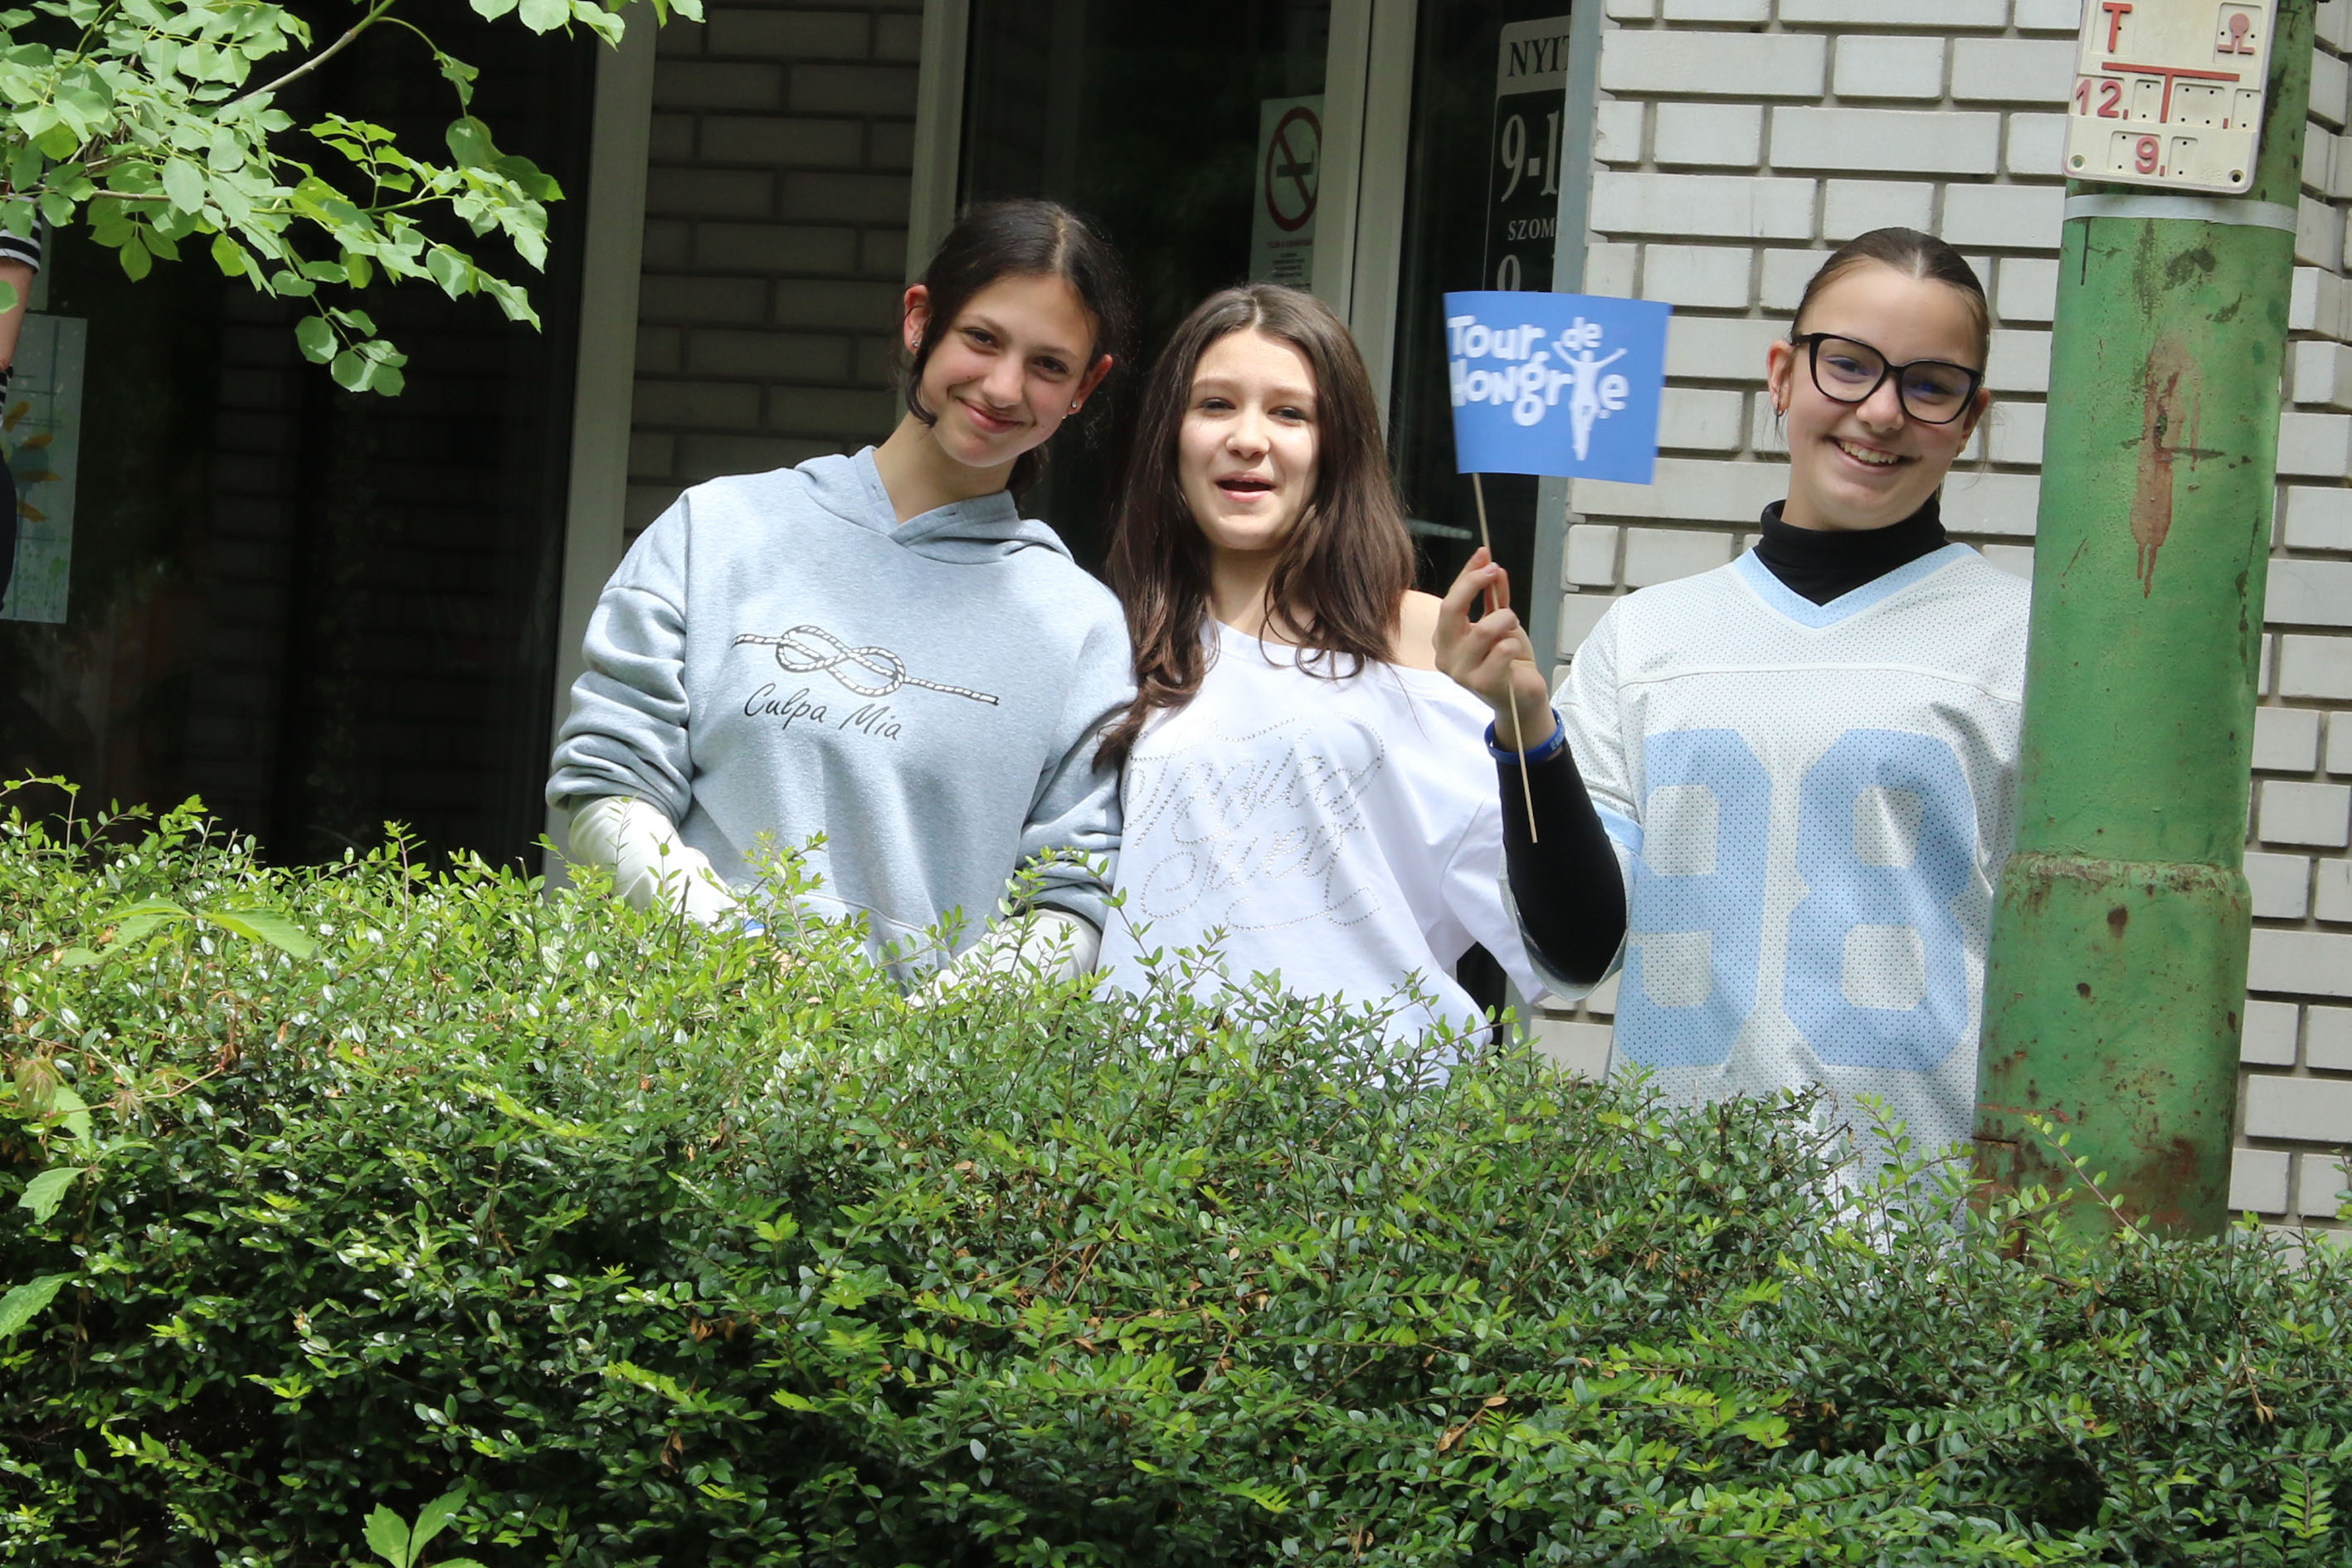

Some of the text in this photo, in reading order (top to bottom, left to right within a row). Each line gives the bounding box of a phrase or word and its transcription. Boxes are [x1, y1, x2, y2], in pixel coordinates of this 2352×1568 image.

[2101, 2, 2133, 53] T
[1447, 314, 1603, 361] Tour de
[744, 683, 902, 741] Culpa Mia
[1614, 728, 1976, 1073] 98
